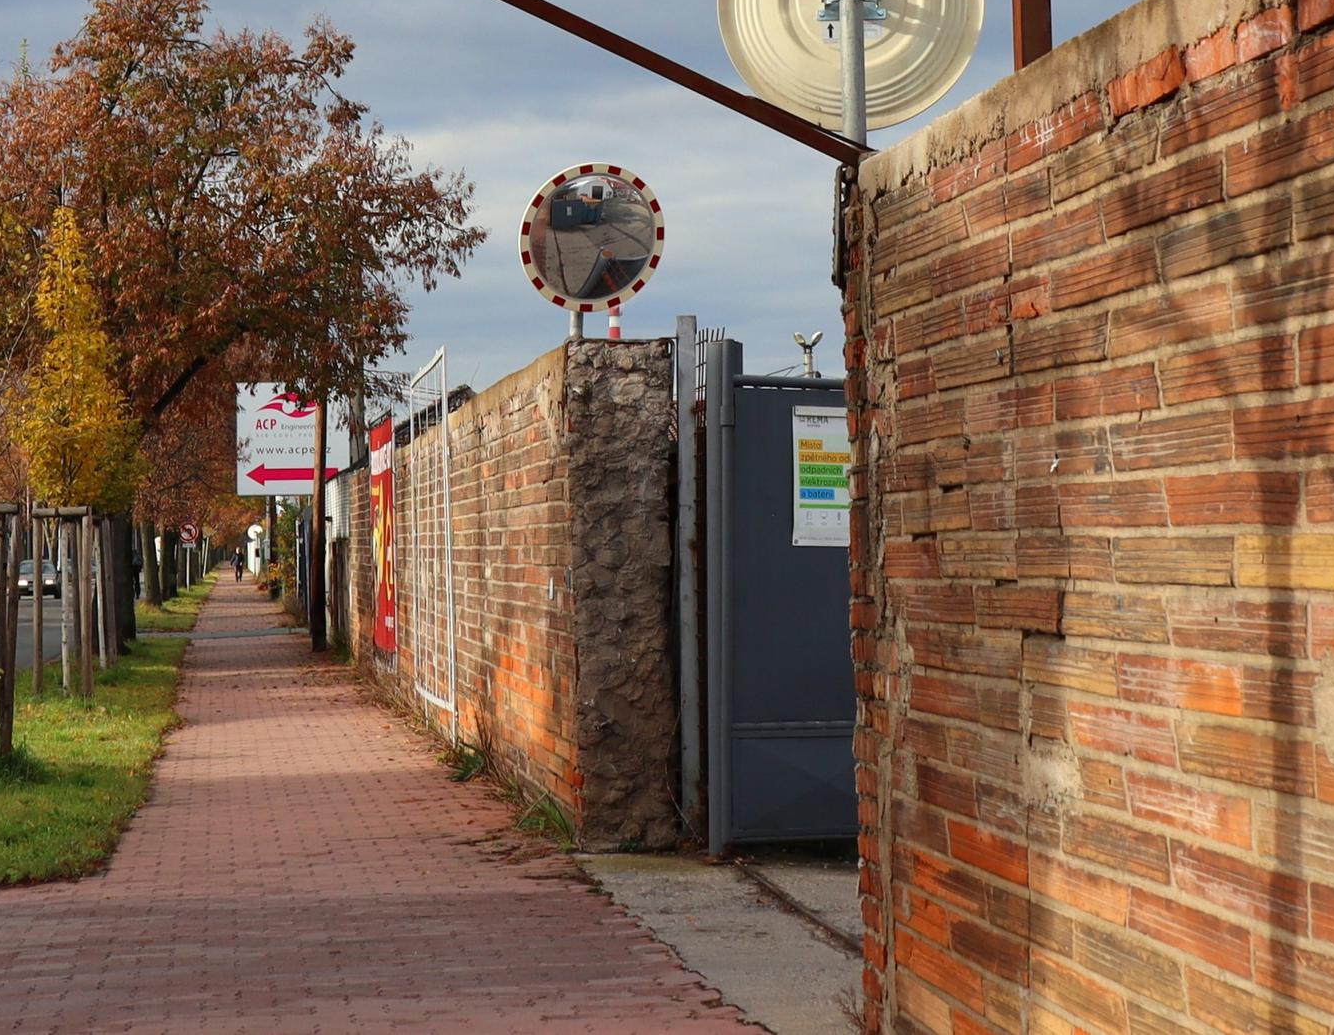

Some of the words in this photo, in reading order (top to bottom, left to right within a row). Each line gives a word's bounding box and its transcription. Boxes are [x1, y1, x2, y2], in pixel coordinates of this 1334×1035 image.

[255, 418, 277, 430] ACP
[281, 423, 317, 431] Engineerin
[255, 446, 332, 456] www.acpez
[800, 476, 848, 486] elektrozaříze
